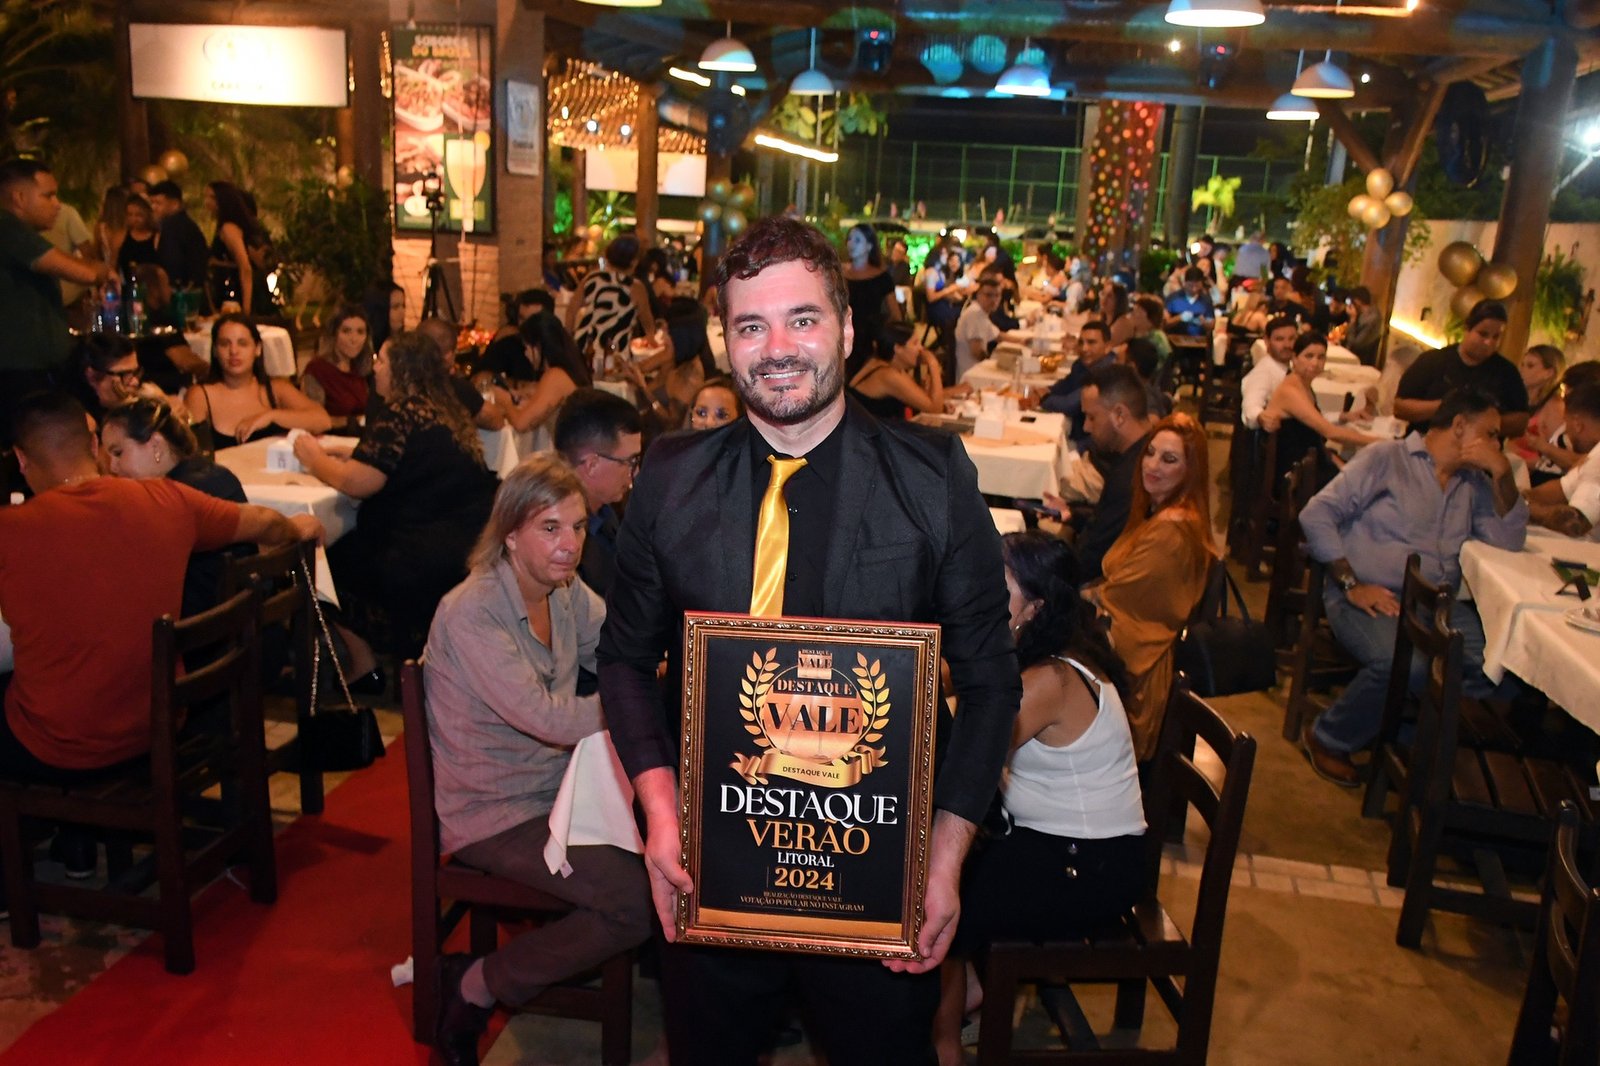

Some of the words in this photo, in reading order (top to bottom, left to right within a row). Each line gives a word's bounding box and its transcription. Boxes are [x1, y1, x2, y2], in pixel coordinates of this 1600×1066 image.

[798, 657, 832, 669] VALE
[777, 679, 853, 696] DESTAQUE
[766, 702, 861, 734] VALE
[783, 766, 821, 777] DESTAQUE
[822, 771, 840, 780] VALE
[720, 784, 898, 828] DESTAQUE
[746, 818, 870, 855] VERÃO
[777, 851, 835, 868] LITORAL
[775, 867, 834, 891] 2024
[739, 895, 775, 906] VOTAÇÃO
[776, 898, 809, 908] POPULAR
[822, 902, 865, 912] INSTAGRAM
